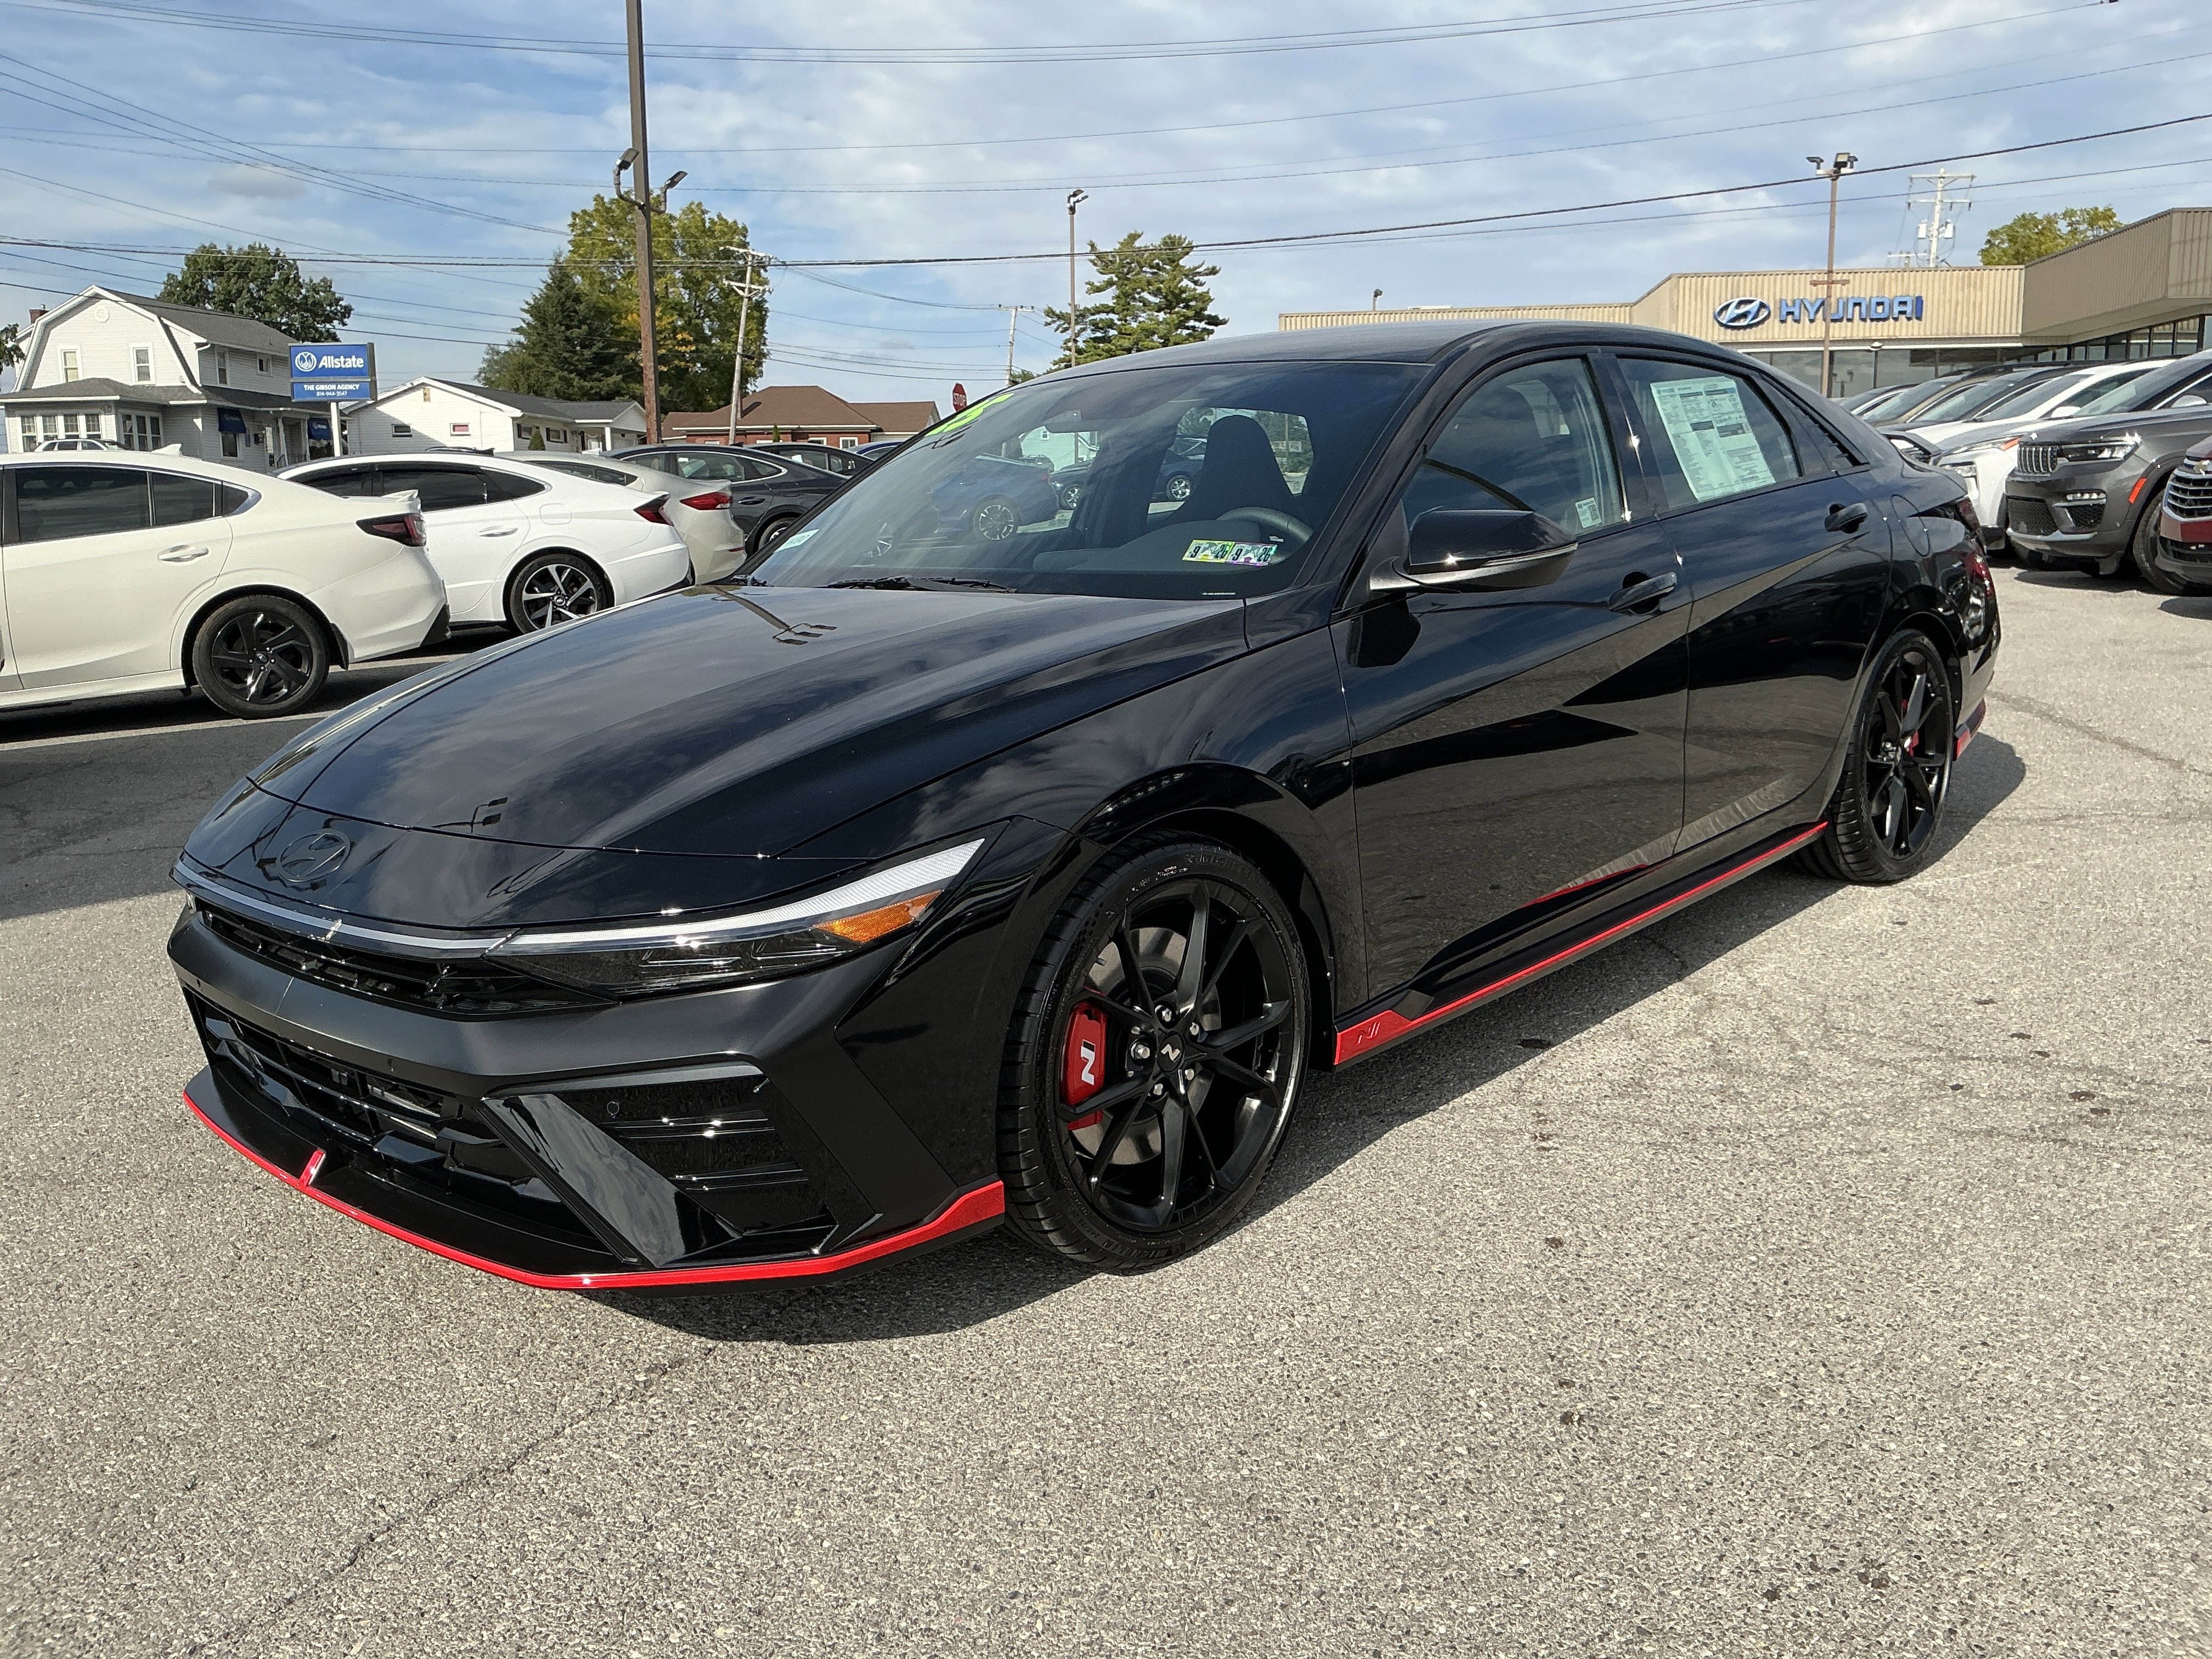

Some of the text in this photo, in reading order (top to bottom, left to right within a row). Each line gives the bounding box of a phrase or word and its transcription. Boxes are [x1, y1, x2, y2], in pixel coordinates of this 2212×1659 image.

[1780, 296, 1924, 322] HYUNDAI
[319, 356, 364, 369] Allstate
[953, 392, 966, 407] STOP
[1190, 546, 1201, 558] 9
[1232, 548, 1243, 561] 9
[1256, 547, 1272, 562] 26
